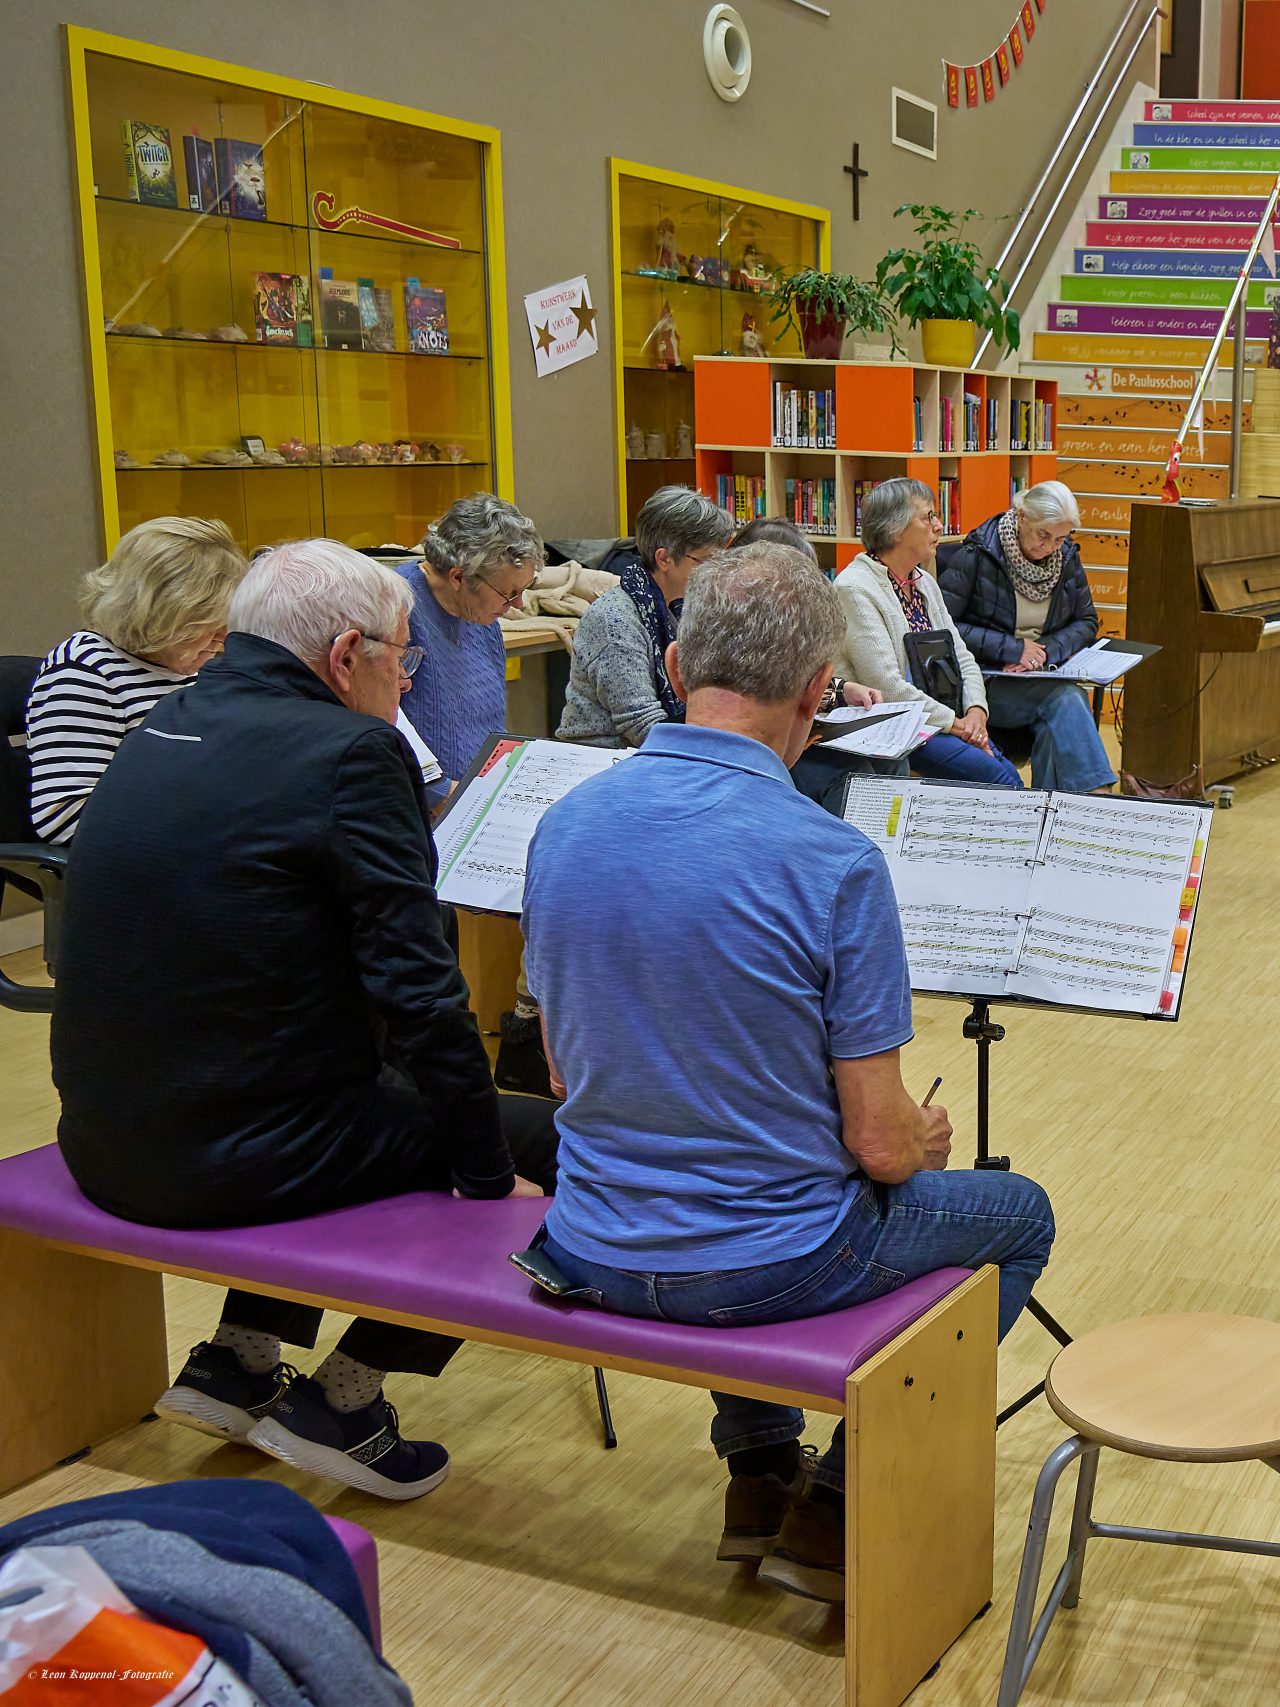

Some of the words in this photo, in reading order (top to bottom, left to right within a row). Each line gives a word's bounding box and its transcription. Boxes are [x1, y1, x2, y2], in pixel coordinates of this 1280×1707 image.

[1187, 107, 1208, 119] School
[1154, 134, 1164, 144] In
[1165, 134, 1175, 144] de
[1193, 135, 1204, 145] en
[1216, 135, 1227, 145] de
[1228, 134, 1249, 146] school
[137, 143, 170, 163] TWITCH
[1137, 207, 1158, 221] Zorg
[1159, 208, 1177, 220] goed
[1178, 209, 1193, 218] voor
[1194, 208, 1206, 218] de
[1207, 208, 1234, 221] spullen
[1247, 210, 1259, 219] en
[1168, 234, 1182, 245] het
[1207, 237, 1224, 245] van
[1225, 236, 1236, 246] de
[1111, 259, 1128, 275] Help
[540, 288, 577, 311] KUNSTWERK
[552, 319, 565, 331] VAN
[565, 314, 574, 327] DE
[1111, 315, 1145, 328] Iedereen
[1156, 318, 1186, 330] anders
[1187, 321, 1199, 330] en
[1199, 319, 1217, 331] dat
[416, 329, 449, 350] KNOTS
[556, 338, 578, 355] MAAND
[1113, 373, 1128, 387] De
[1129, 373, 1193, 390] Paulusschool
[1099, 442, 1114, 451] en
[1118, 441, 1144, 453] aan
[1147, 438, 1168, 455] het
